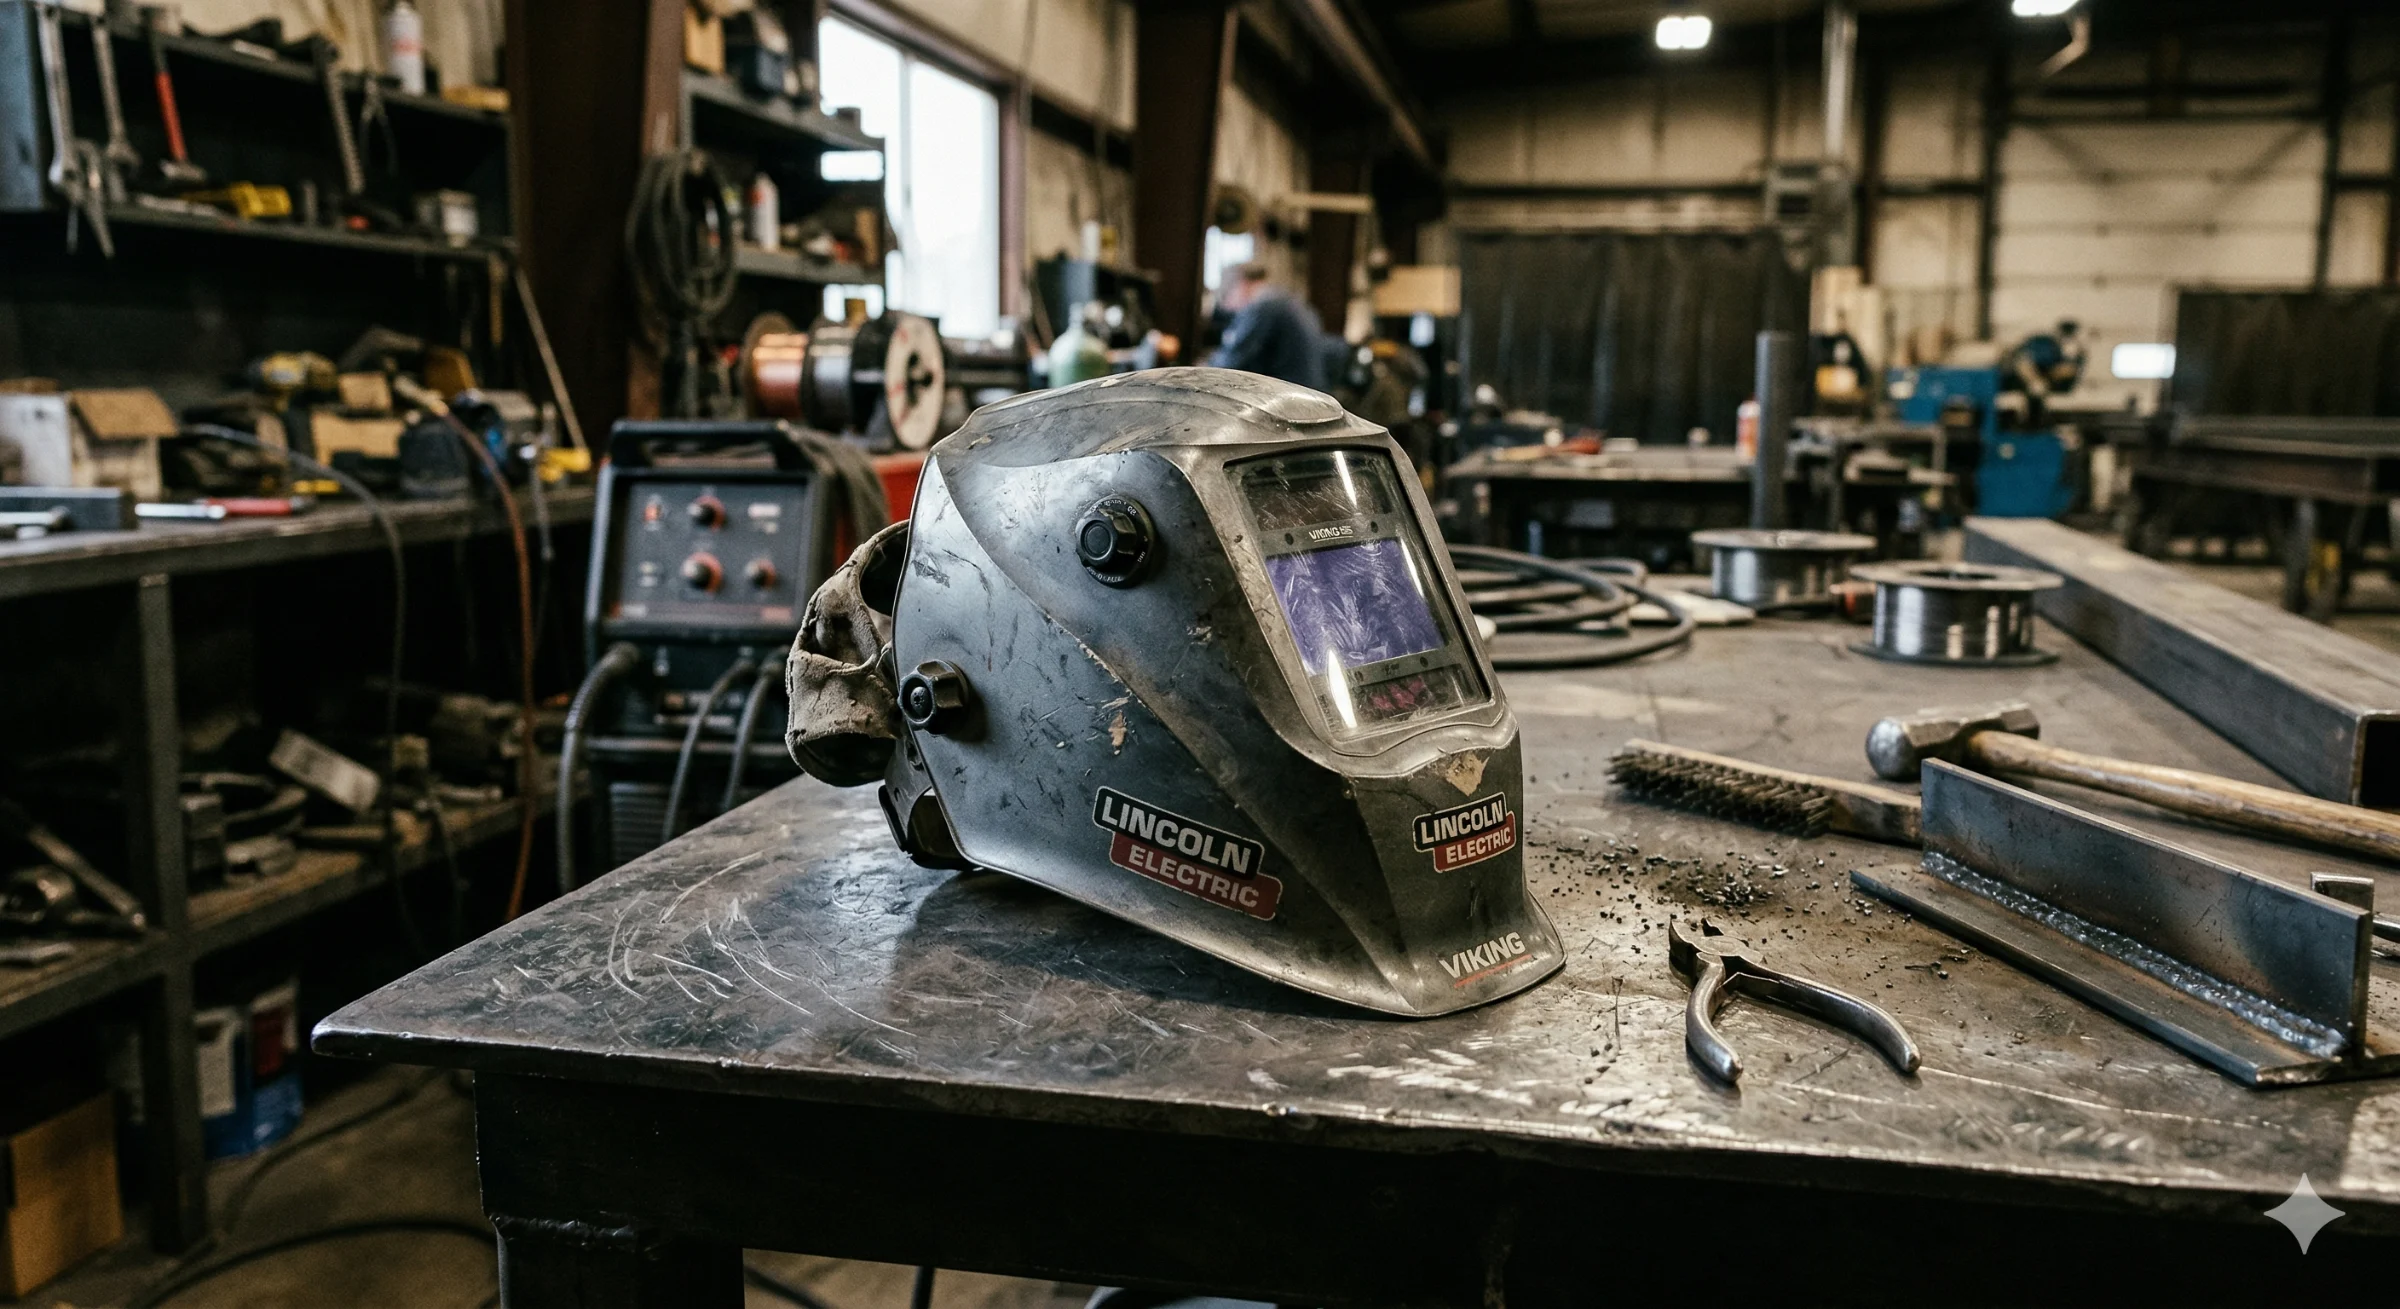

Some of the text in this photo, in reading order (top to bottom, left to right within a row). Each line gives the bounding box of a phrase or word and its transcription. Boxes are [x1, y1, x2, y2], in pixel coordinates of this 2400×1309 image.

[1101, 796, 1252, 874] LINCOLN
[1420, 799, 1504, 845] LINCOLN
[1446, 826, 1511, 864] ELECTRIC
[1128, 844, 1260, 908] ELECTRIC
[1439, 931, 1526, 979] VIKING
